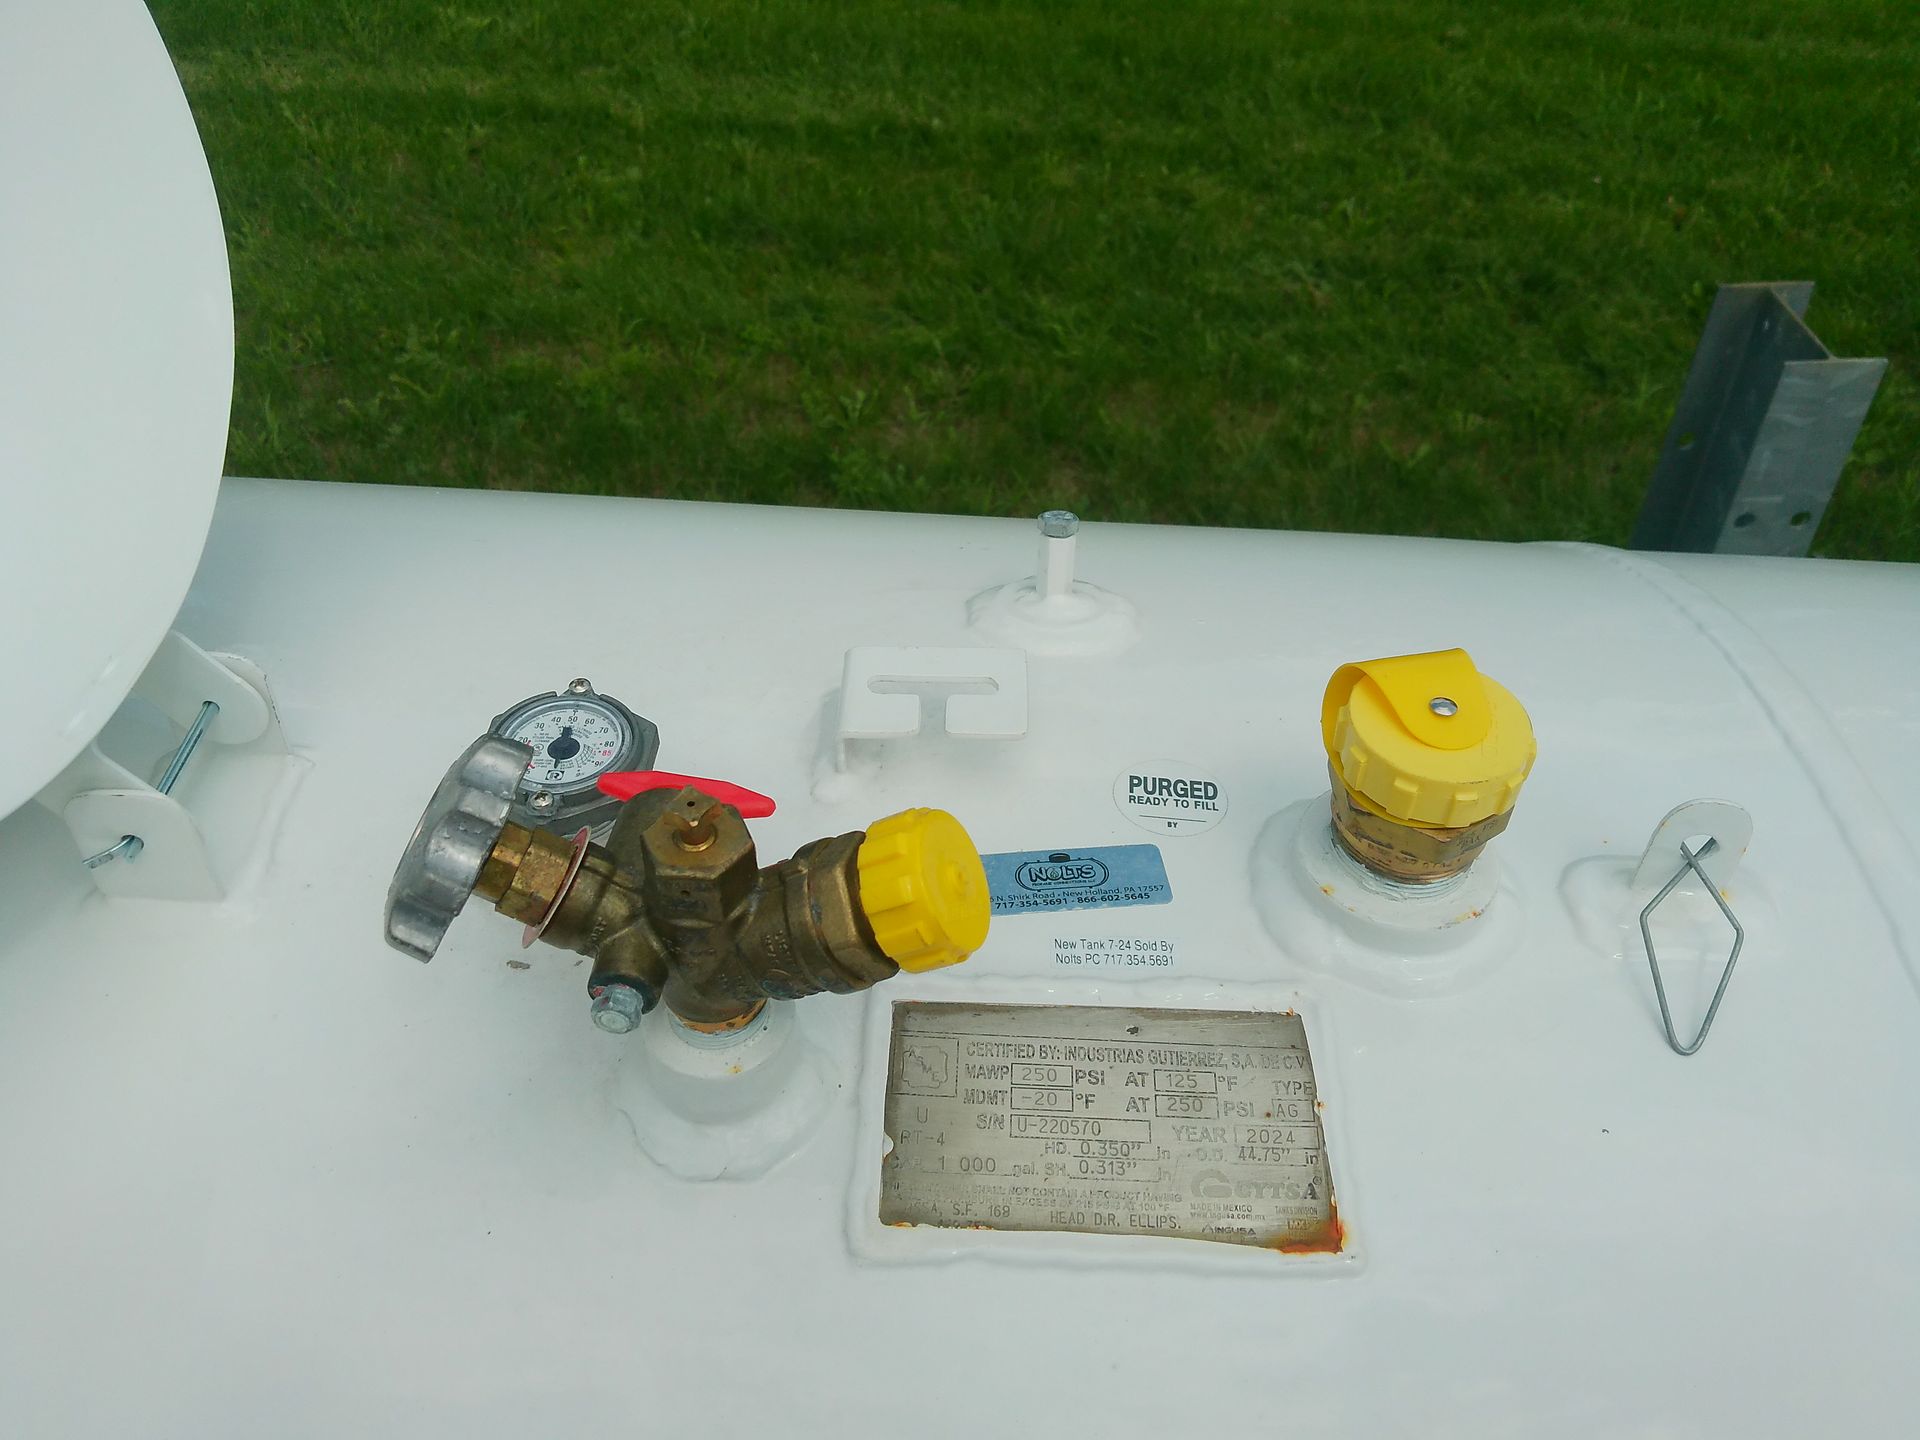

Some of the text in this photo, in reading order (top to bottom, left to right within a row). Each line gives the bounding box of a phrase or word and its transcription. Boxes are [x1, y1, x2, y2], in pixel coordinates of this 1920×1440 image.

[534, 722, 545, 730] 30
[1129, 775, 1218, 800] PURGED
[1129, 795, 1219, 812] READY TO FILL
[1167, 821, 1178, 829] BY
[1028, 863, 1096, 883] NOLTS
[995, 898, 1069, 910] 717-354-5691
[1077, 892, 1151, 904] 866-602-5645
[1008, 893, 1031, 902] Shirk
[1033, 891, 1056, 900] Road
[1062, 890, 1083, 898] New
[1085, 887, 1122, 898] Holland,
[1138, 884, 1165, 893] 17557
[1055, 939, 1174, 953] New Tank 7-24 Sold By
[1056, 953, 1175, 967] Nolts PC 717.354.5691
[966, 1041, 1036, 1060] CERTIFIED
[1039, 1044, 1060, 1060] BY:
[1064, 1045, 1145, 1064] INDUSTRIAS
[1148, 1050, 1228, 1069] GUTIERREZ,
[965, 1063, 1238, 1092] MAWP 250 PSI AT 125 °F
[1272, 1080, 1313, 1096] TYPE
[963, 1088, 1298, 1118] MDMT -20 °F AT 250 PSI AG
[916, 1106, 928, 1124] U
[976, 1113, 1296, 1144] S/N U-220570 YEAR 2024
[900, 1130, 945, 1146] RT-4
[1044, 1142, 1072, 1155] HD.
[1156, 1146, 1171, 1160] in
[1305, 1152, 1319, 1166] in
[938, 1156, 946, 1170] 1
[960, 1157, 997, 1173] 000
[1012, 1162, 1039, 1177] gal.
[1008, 1186, 1030, 1196] NOT
[1032, 1187, 1078, 1198] CONTAIN
[1143, 1192, 1183, 1202] HAVING
[1016, 1197, 1056, 1207] EXCESS
[952, 1204, 978, 1216] S.F.
[1050, 1211, 1085, 1225] HEAD
[1094, 1213, 1120, 1227] D.R.
[1129, 1214, 1182, 1229] ELLIPS.
[1190, 1203, 1212, 1211] MADE
[1222, 1204, 1253, 1213] MEXICO
